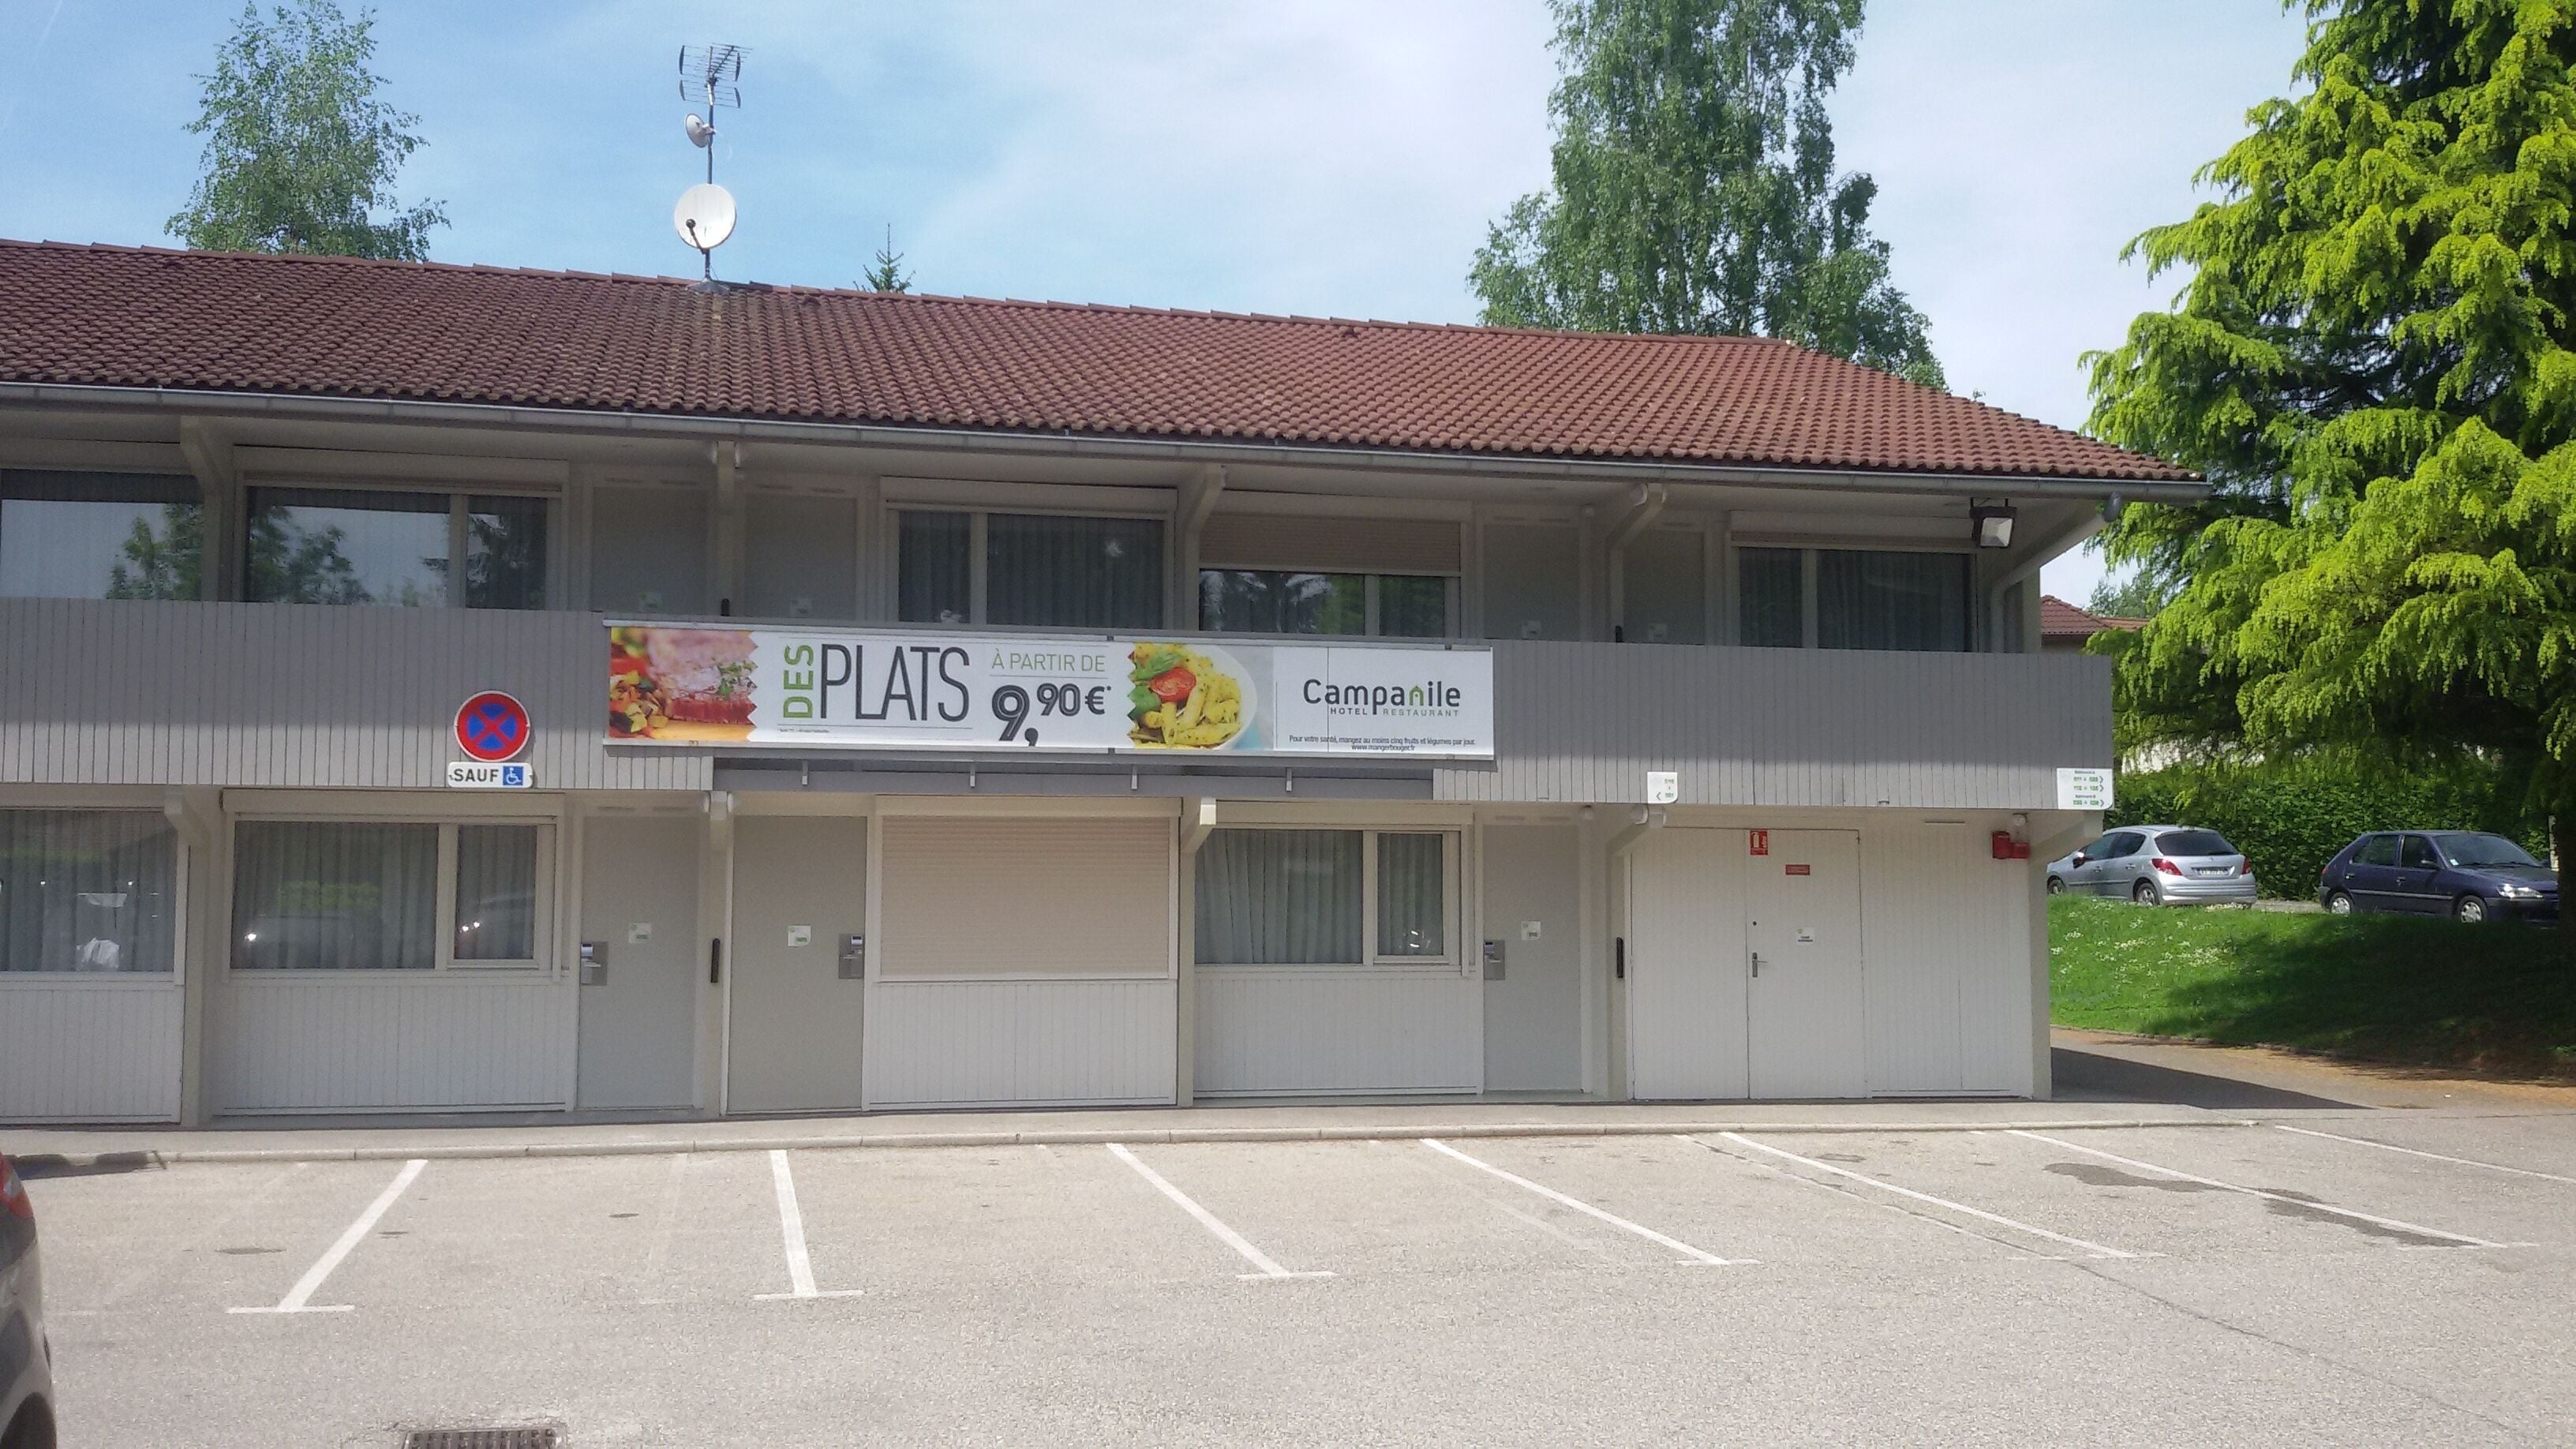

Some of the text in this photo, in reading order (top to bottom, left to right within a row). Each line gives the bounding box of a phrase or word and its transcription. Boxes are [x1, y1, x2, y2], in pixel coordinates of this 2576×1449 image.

[991, 648, 1106, 672] À PARTIR DE
[783, 644, 814, 719] DES
[820, 643, 970, 722] PLATS
[1303, 679, 1461, 715] Campanile
[1330, 707, 1459, 717] HOTEL RESTAURANT
[1320, 735, 1338, 743] santé,
[1339, 736, 1362, 745] mangez
[1391, 736, 1403, 745] cinq
[1427, 736, 1451, 746] légumes
[1463, 738, 1476, 747] jour.
[454, 768, 500, 782] SAUF
